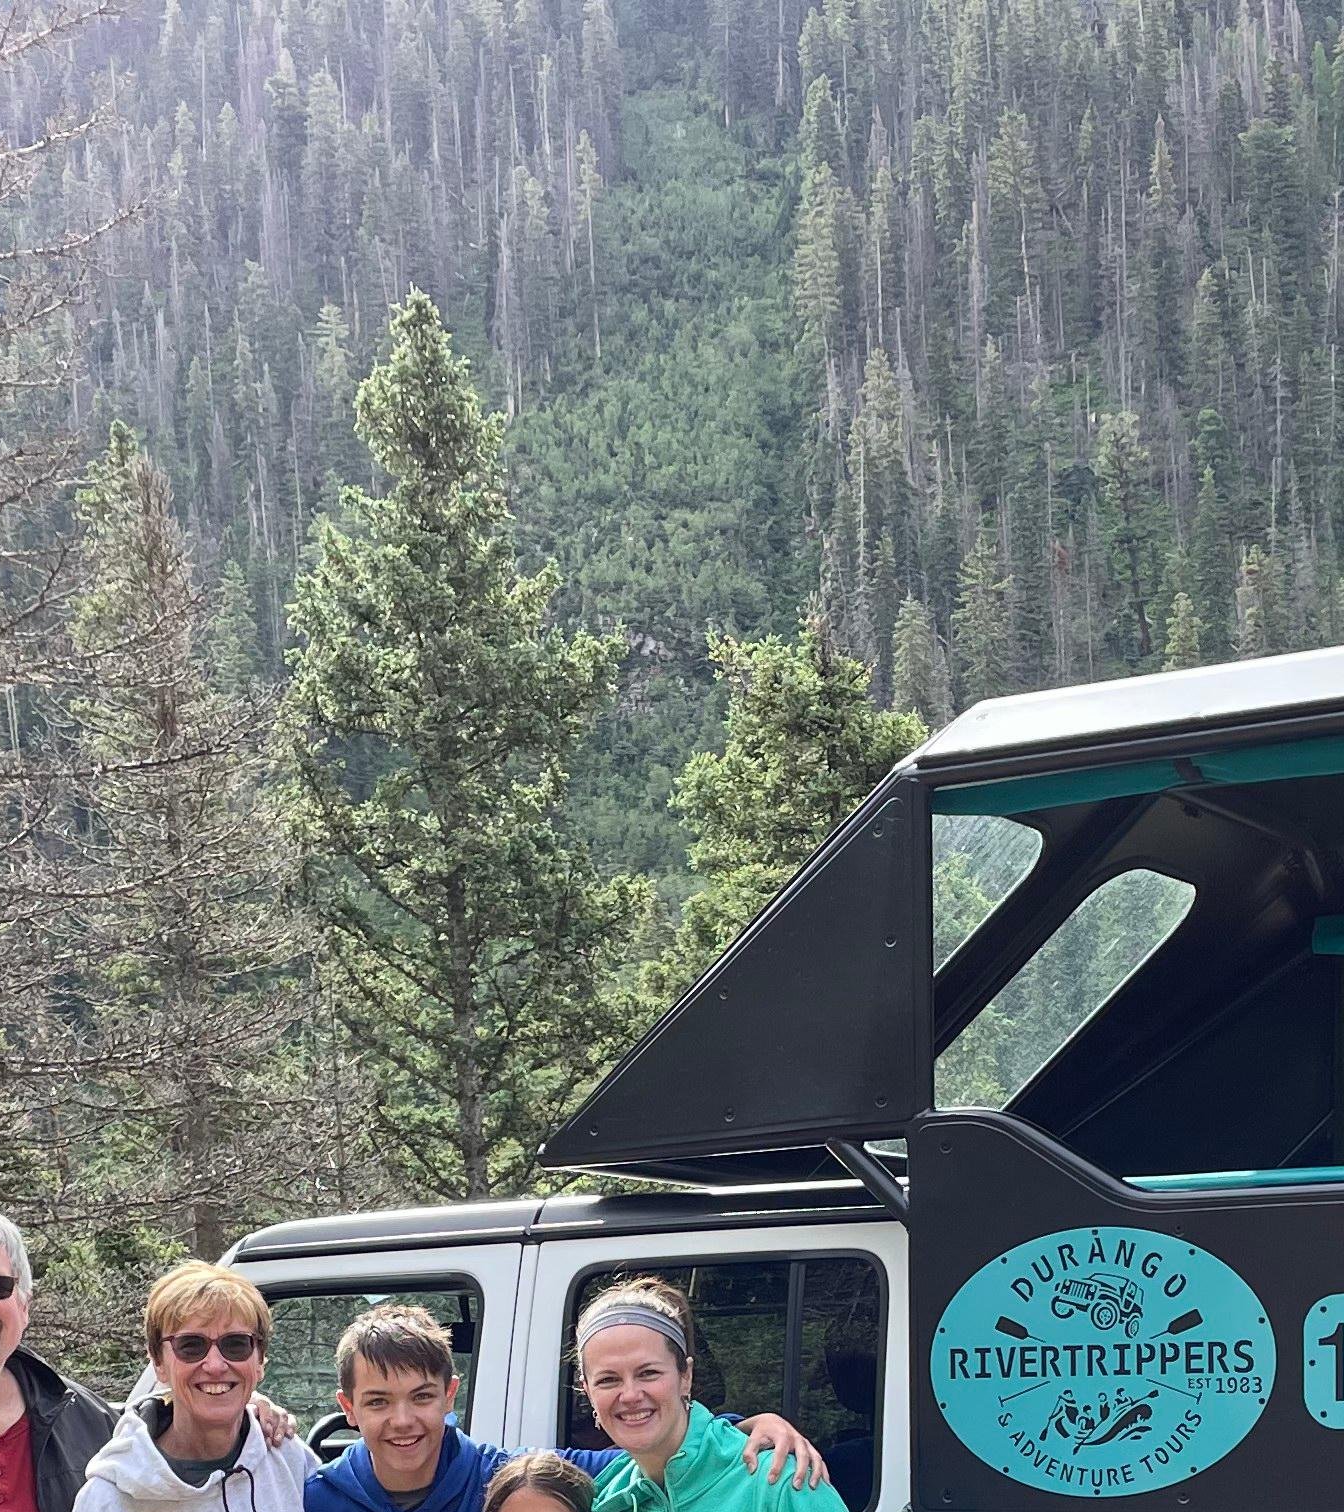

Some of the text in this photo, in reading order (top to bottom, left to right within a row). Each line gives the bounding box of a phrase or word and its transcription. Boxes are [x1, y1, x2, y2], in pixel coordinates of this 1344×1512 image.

[1010, 1237, 1187, 1302] DURANGO
[950, 1339, 1255, 1380] RIVERTRIPPERS
[1187, 1375, 1263, 1394] EST 1983
[998, 1410, 1203, 1487] & ADVENTURE TOURS
